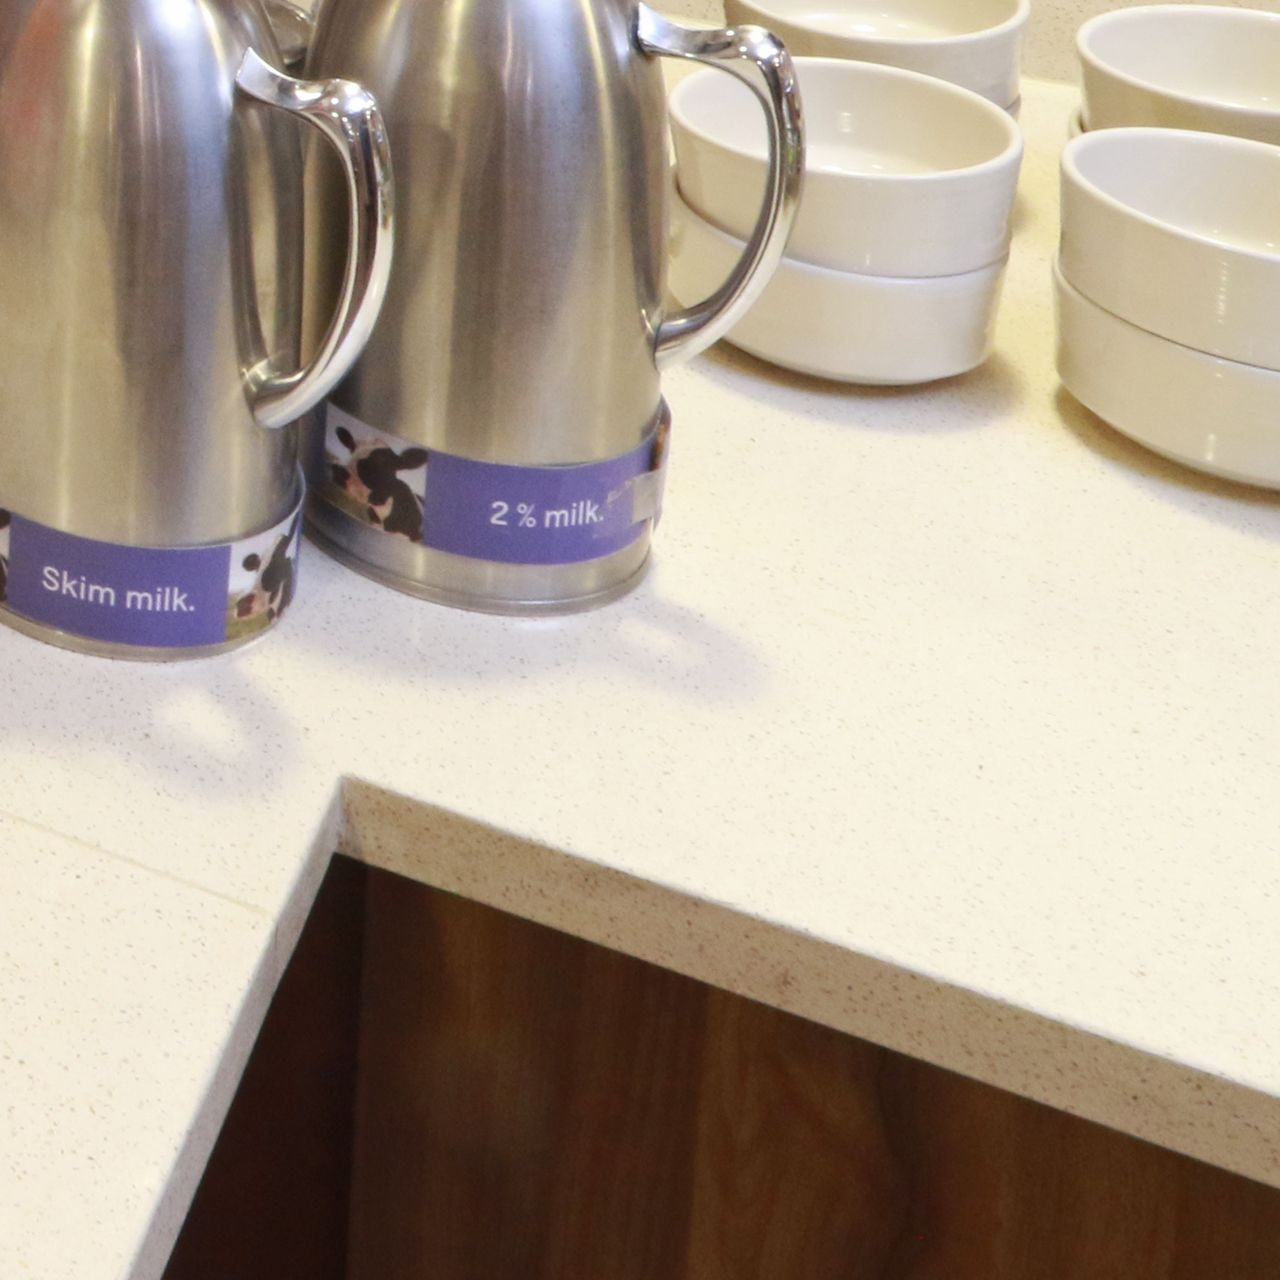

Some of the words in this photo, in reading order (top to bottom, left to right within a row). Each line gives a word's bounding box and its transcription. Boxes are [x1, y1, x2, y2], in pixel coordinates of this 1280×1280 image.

[490, 499, 508, 526] 2
[516, 503, 537, 528] %
[42, 565, 117, 606] Skim
